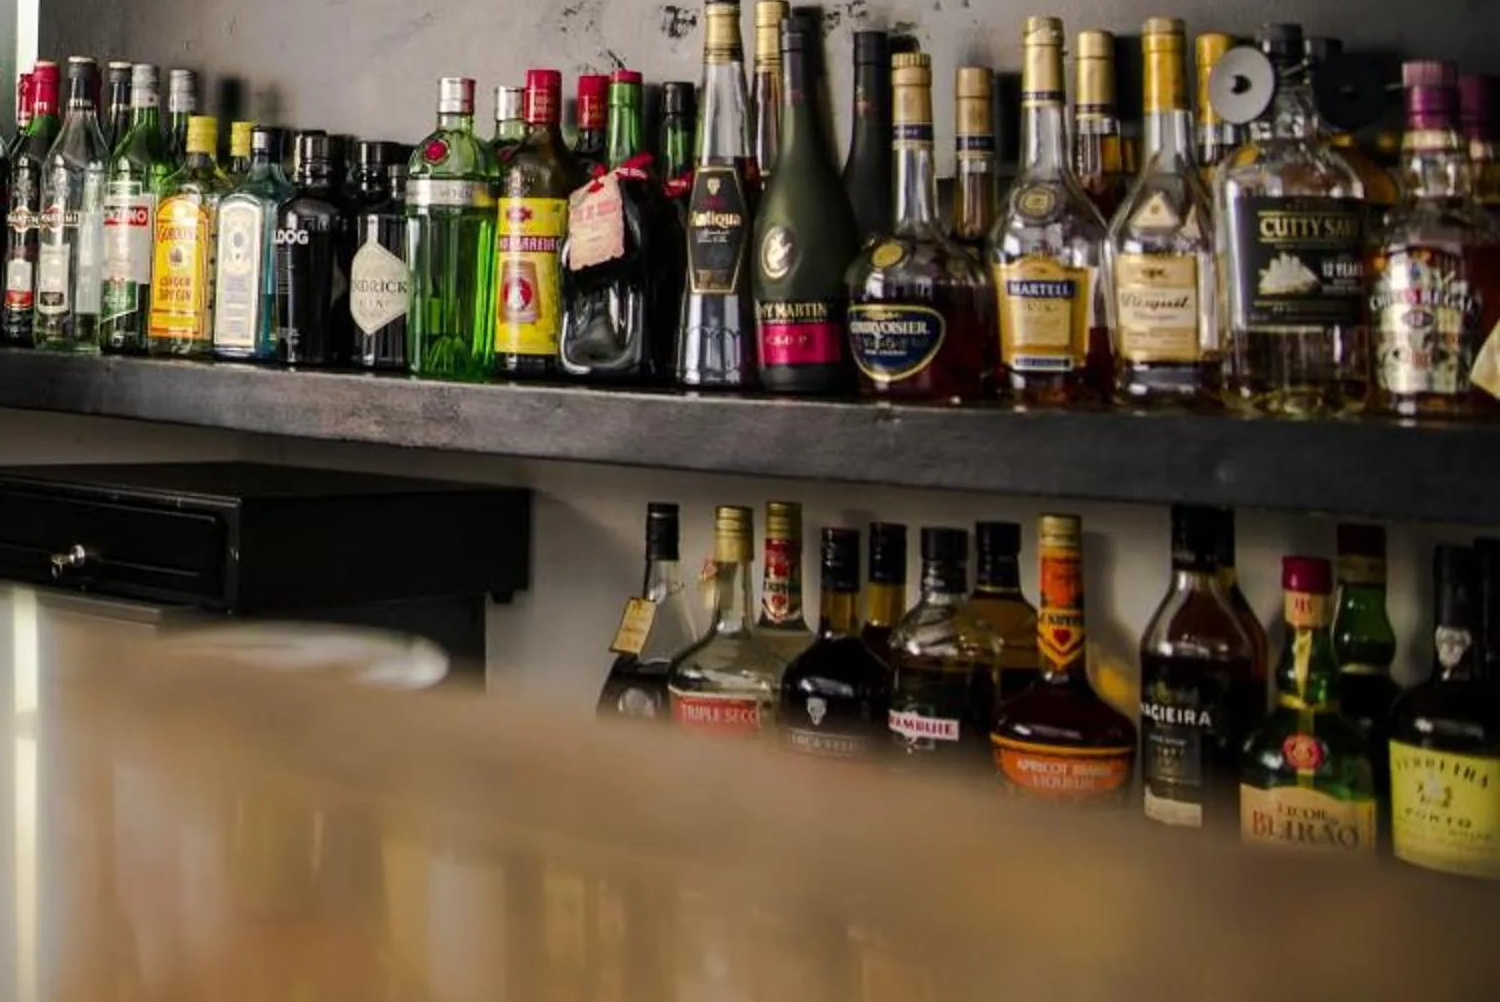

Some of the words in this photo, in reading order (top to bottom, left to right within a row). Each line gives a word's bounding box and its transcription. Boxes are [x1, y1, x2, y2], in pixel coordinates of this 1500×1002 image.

[1258, 215, 1321, 237] CUTTY
[1009, 281, 1071, 297] MARTELL
[775, 301, 828, 319] MARTIN
[680, 701, 720, 720] TRIPLE
[1276, 801, 1327, 820] LICOR
